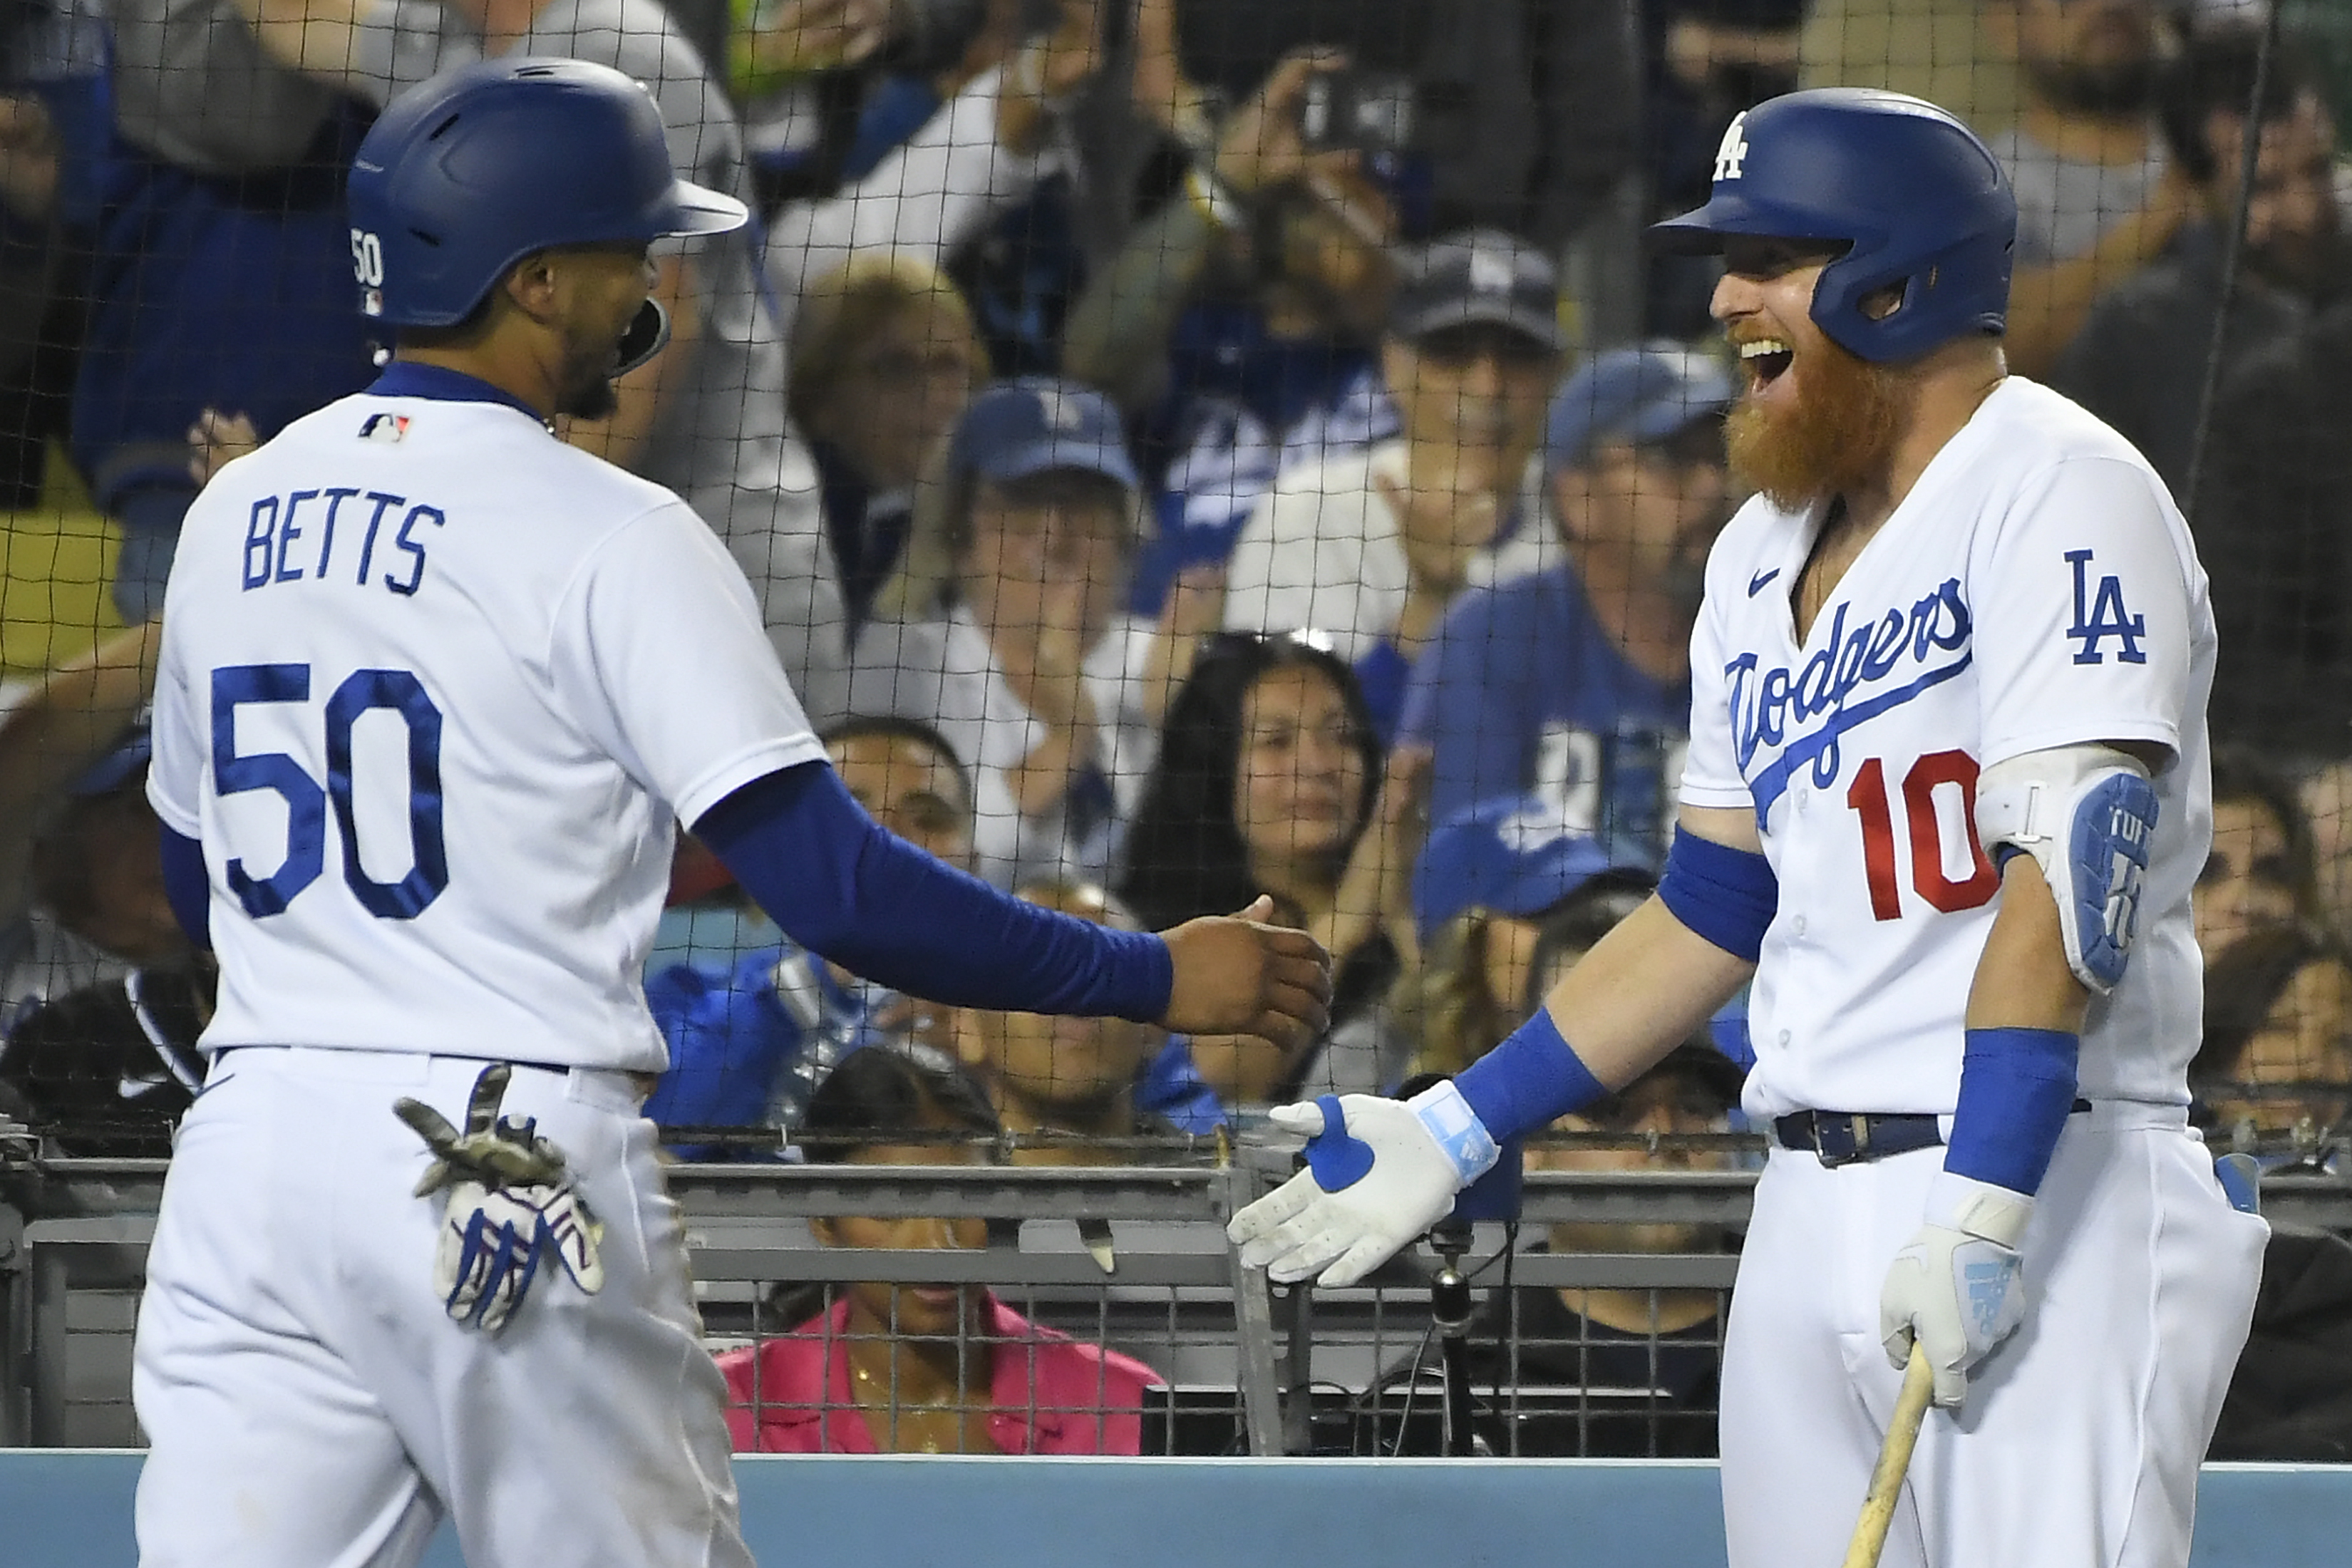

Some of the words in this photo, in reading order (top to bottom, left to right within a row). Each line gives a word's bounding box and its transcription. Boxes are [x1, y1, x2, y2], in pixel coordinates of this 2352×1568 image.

[351, 228, 383, 287] 50
[242, 488, 445, 597] BETTS
[2063, 548, 2147, 665] LA
[1724, 577, 1973, 791] Dodgers
[210, 663, 449, 920] 50
[1847, 748, 2003, 922] 10
